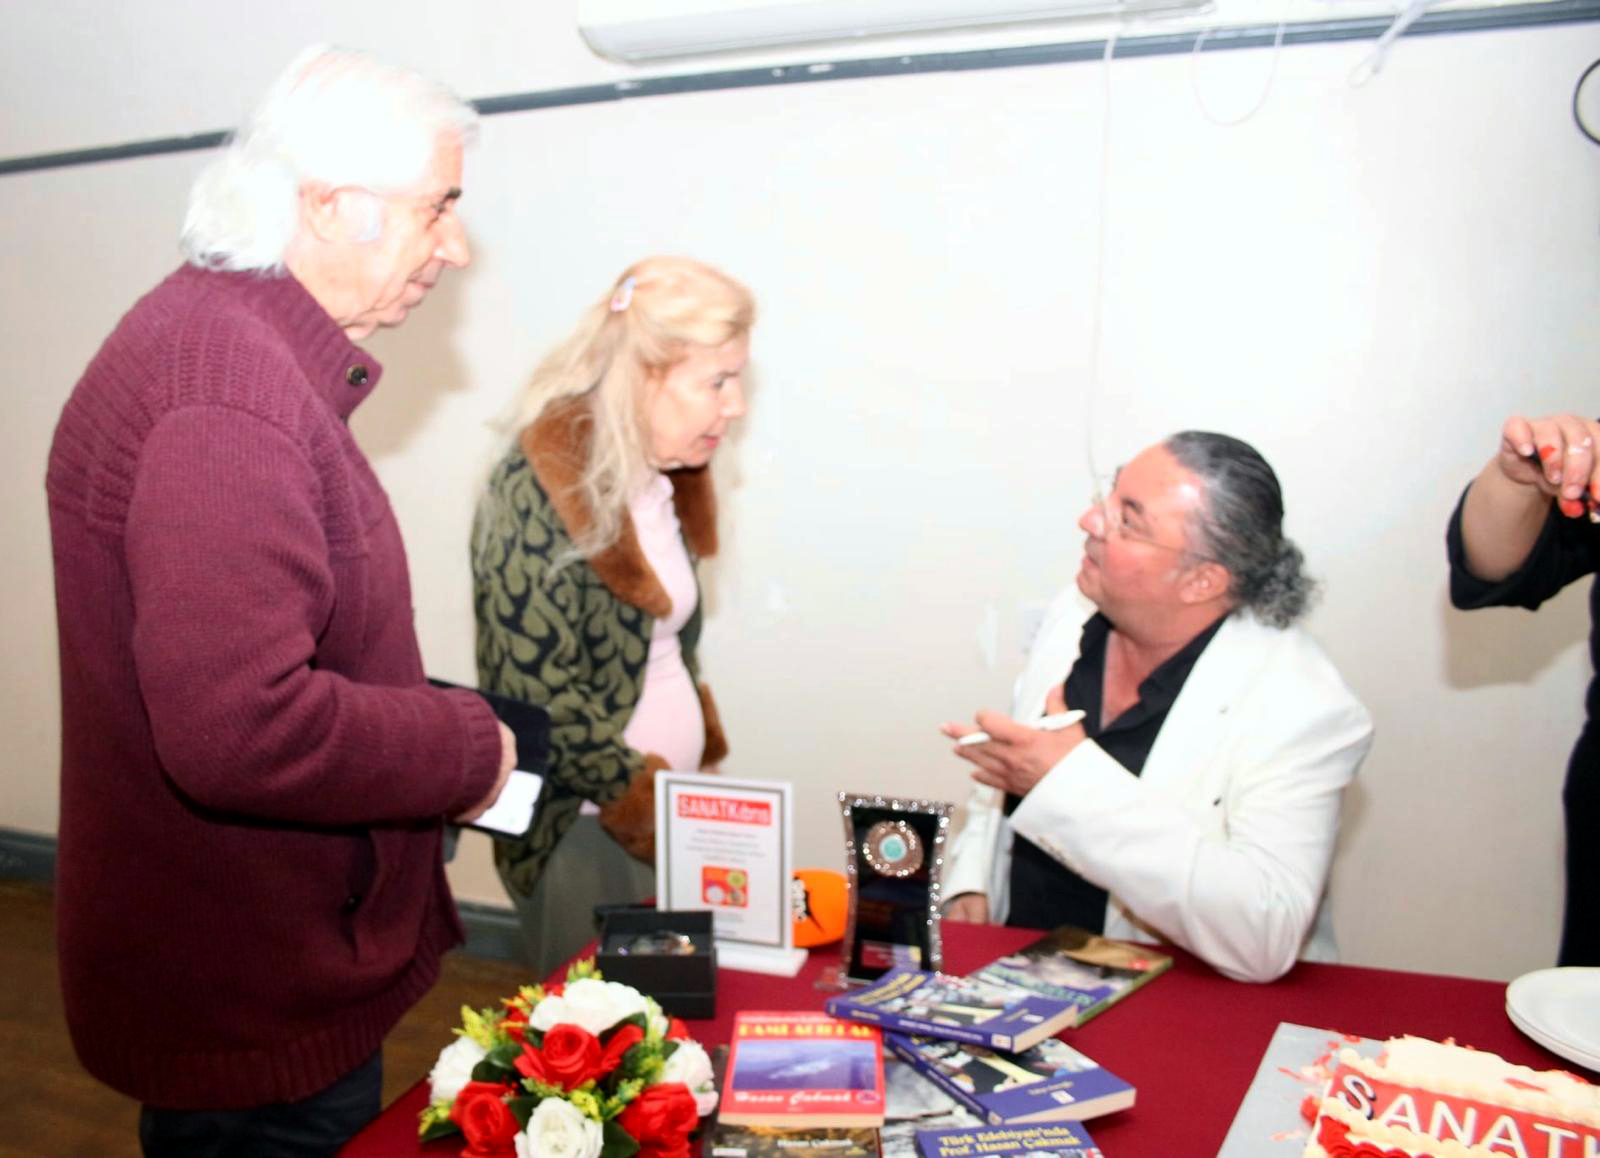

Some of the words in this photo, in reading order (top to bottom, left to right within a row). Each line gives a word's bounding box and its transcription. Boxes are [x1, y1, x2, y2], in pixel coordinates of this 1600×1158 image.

[937, 1134, 975, 1147] Türk
[975, 1140, 1021, 1153] Hasan
[1022, 1135, 1082, 1149] Çakmak
